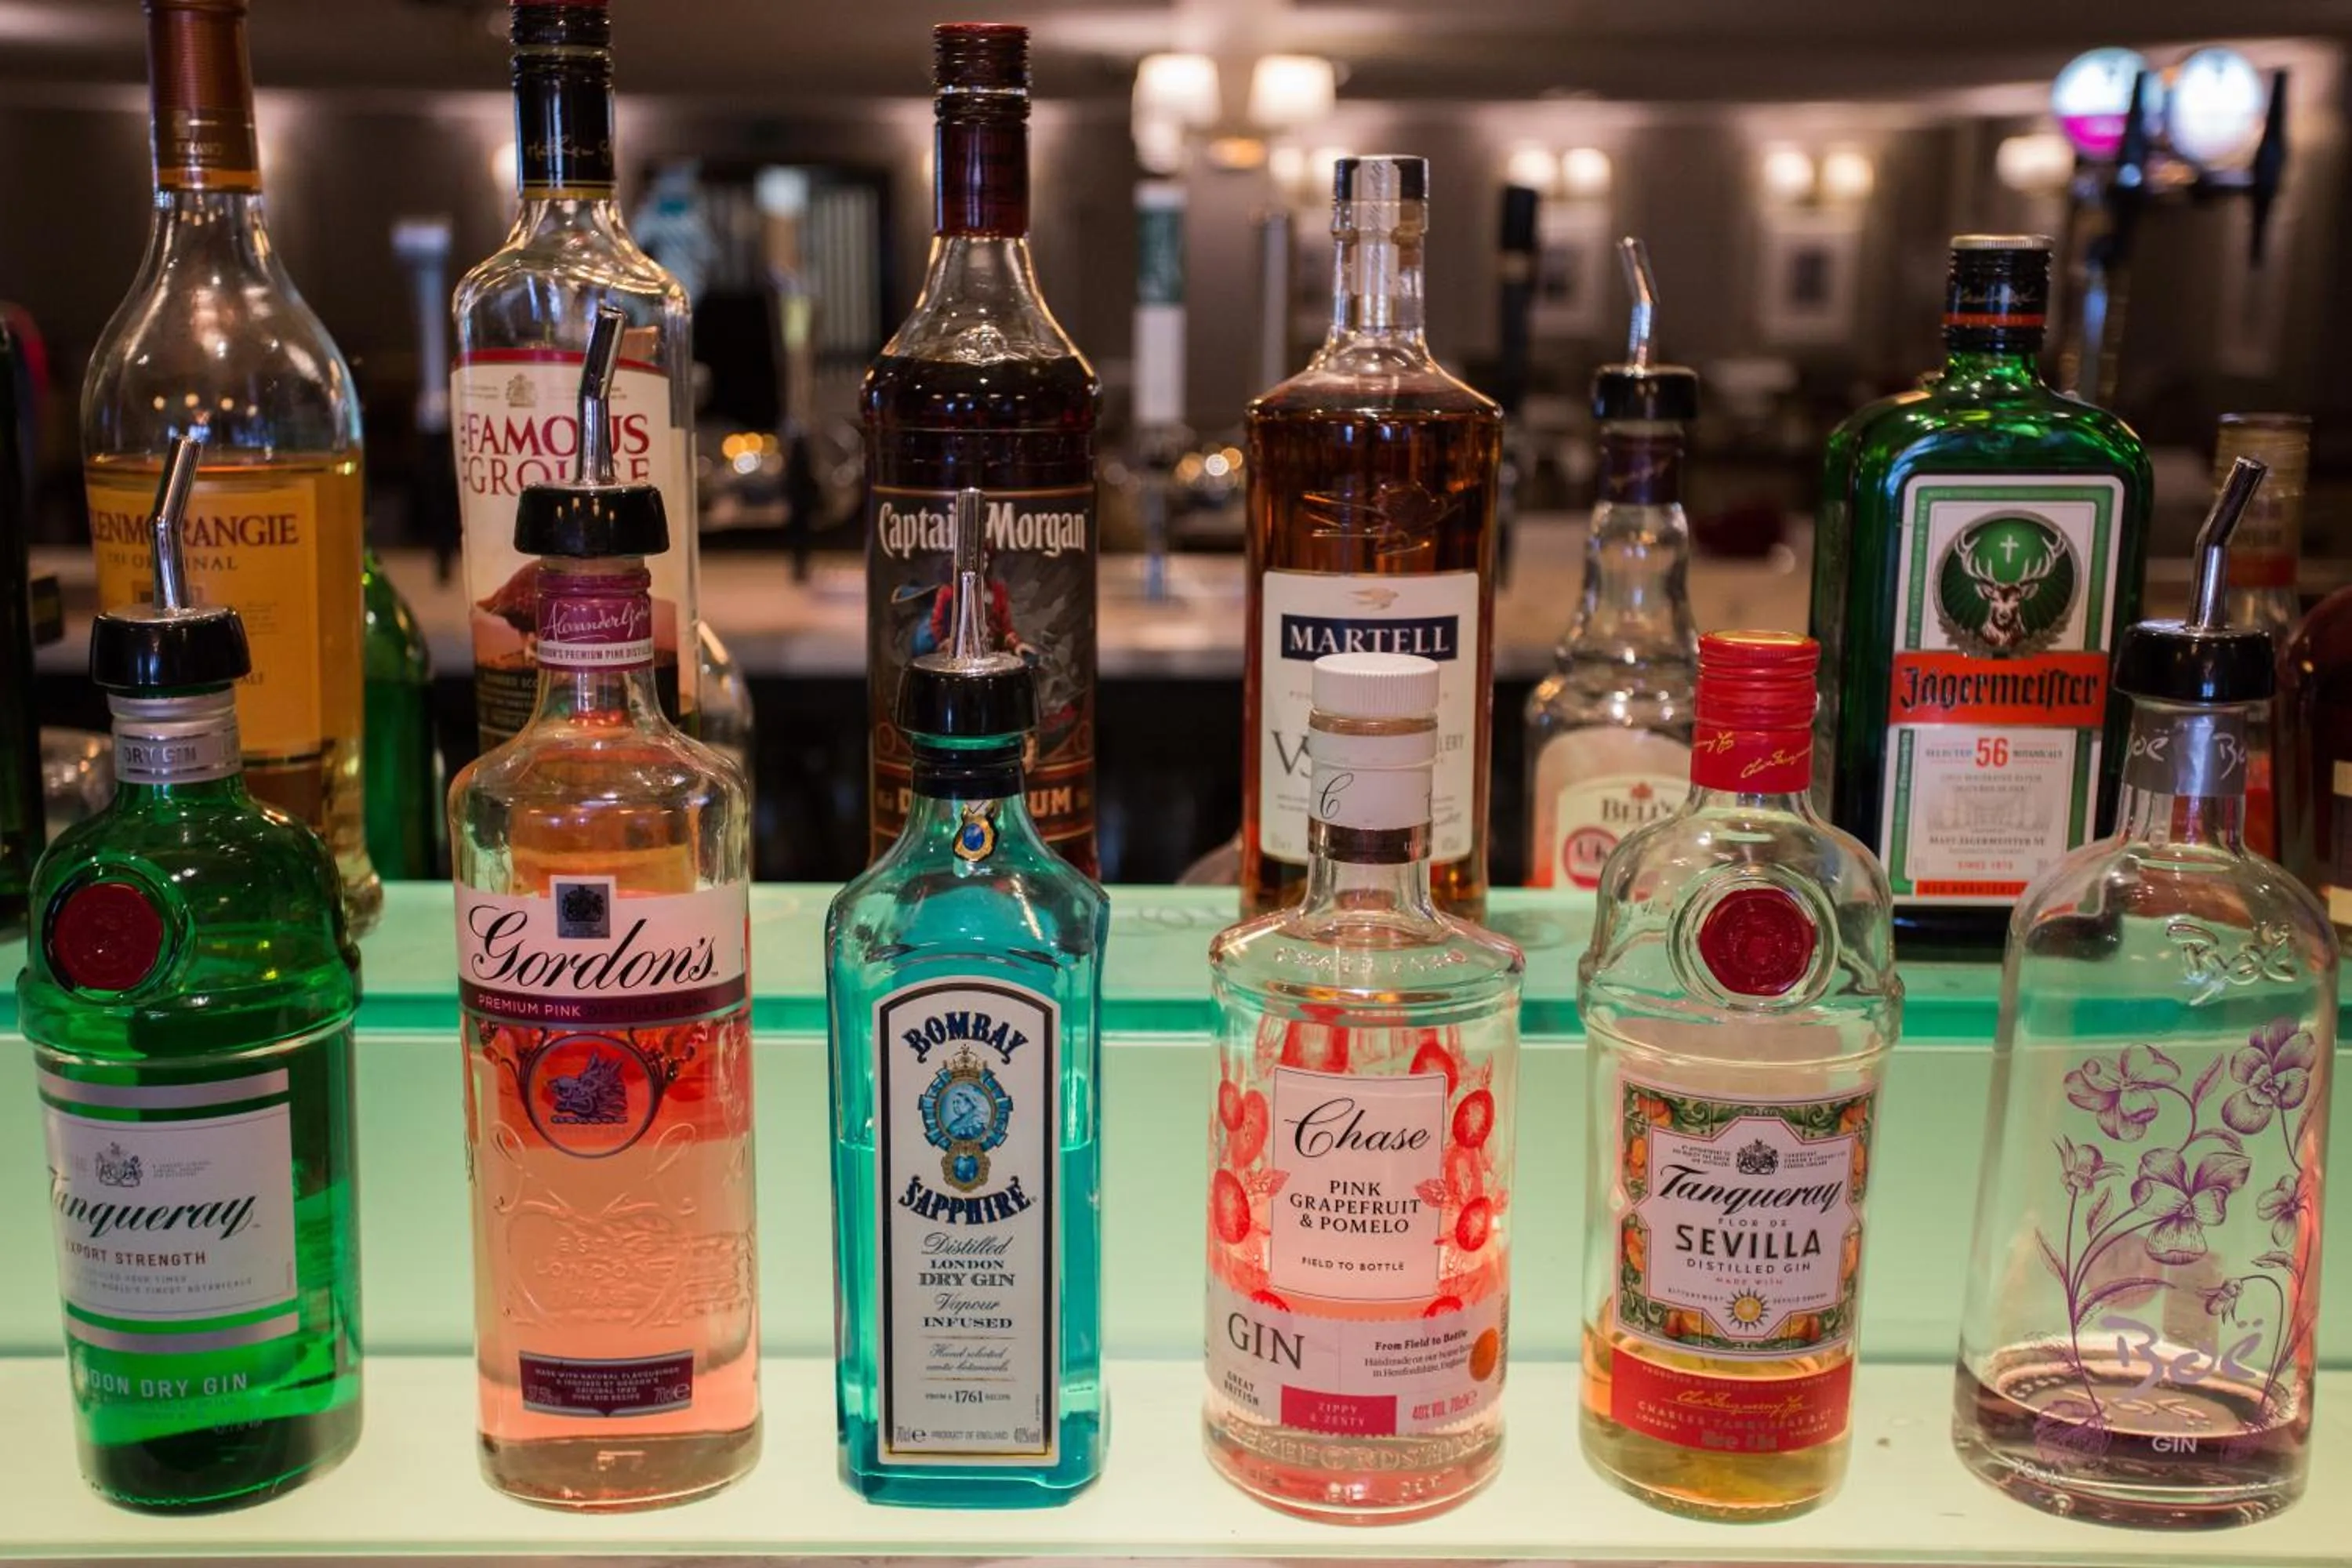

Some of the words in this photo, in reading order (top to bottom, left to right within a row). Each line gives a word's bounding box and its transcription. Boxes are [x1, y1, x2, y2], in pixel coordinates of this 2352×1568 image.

[879, 502, 957, 559] Captai
[985, 502, 1086, 557] Morgan
[1290, 625, 1449, 654] MARTELL
[1975, 736, 2009, 768] 56
[1029, 786, 1073, 815] UM
[1318, 772, 1354, 819] C
[469, 904, 715, 990] Gordon's
[478, 993, 539, 1014] PREMIUM
[544, 1004, 581, 1017] PINK
[902, 1011, 1029, 1065] BOMBAY
[1284, 1098, 1430, 1158] Chase
[898, 1174, 1031, 1225] SAPPHIRE
[1330, 1180, 1381, 1197] PINK
[1659, 1163, 1843, 1215] Tanqueray
[1290, 1192, 1421, 1215] GRAPEFRUIT
[1300, 1213, 1313, 1228] &
[1320, 1218, 1409, 1234] POMELO
[1718, 1218, 1759, 1228] FLOR
[921, 1232, 1014, 1255] Distilled
[1675, 1224, 1821, 1260] SEVILLA
[115, 1250, 207, 1267] STRENGTH
[930, 1259, 1004, 1270] LONDON
[1301, 1256, 1334, 1269] FIELD
[1338, 1261, 1355, 1272] TO
[1359, 1261, 1405, 1272] BOTTLE
[1686, 1258, 1775, 1274] DISTILLED
[1784, 1261, 1811, 1274] GIN
[919, 1272, 967, 1287] DRY
[971, 1272, 1016, 1287] GIN
[935, 1293, 1000, 1315] Vapour
[923, 1316, 1013, 1329] INFUSED
[1228, 1312, 1305, 1370] GIN
[1375, 1341, 1402, 1351] From
[1404, 1337, 1430, 1349] Field
[84, 1368, 130, 1396] DON
[140, 1379, 189, 1399] DRY
[203, 1373, 247, 1396] GIN
[1224, 1379, 1259, 1406] BRITISH
[1226, 1370, 1255, 1392] GREAT
[954, 1391, 983, 1403] 1761
[1318, 1402, 1358, 1414] ZIPPY
[2151, 1436, 2198, 1454] GIN
